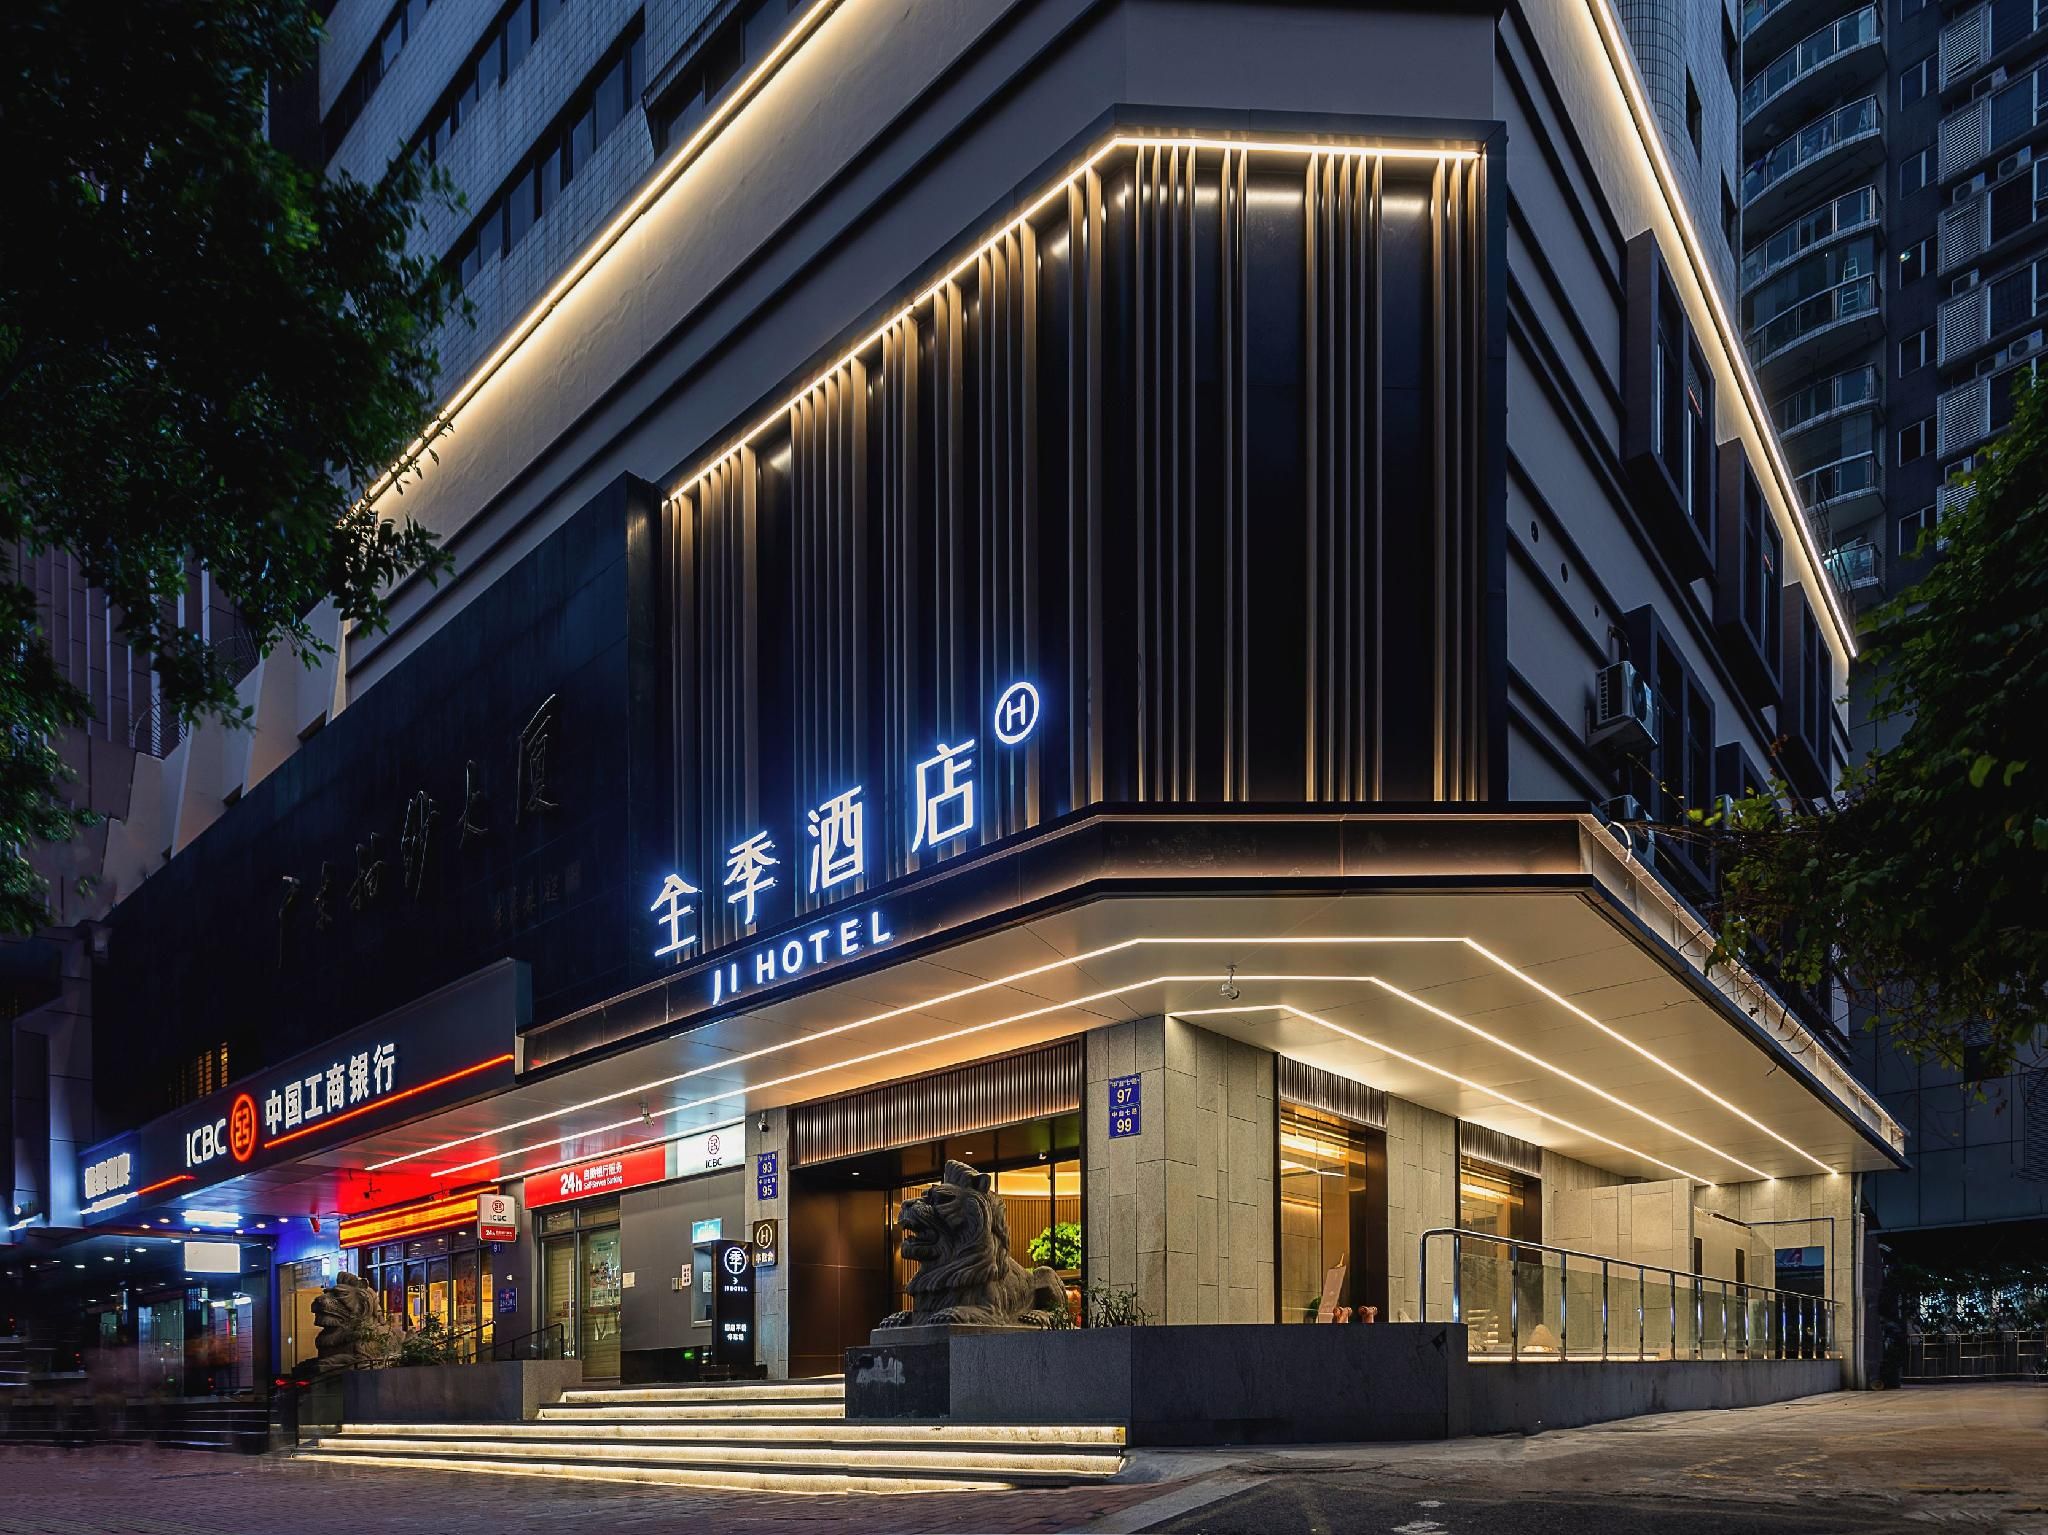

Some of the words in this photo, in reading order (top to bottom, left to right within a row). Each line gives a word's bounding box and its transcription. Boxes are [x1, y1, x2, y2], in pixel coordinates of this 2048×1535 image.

[651, 739, 975, 957] 全季酒店
[712, 964, 738, 1006] JI
[756, 912, 891, 984] HOTEL
[265, 1043, 395, 1136] 中国工商银行
[1117, 1088, 1132, 1104] 97
[1117, 1117, 1132, 1133] 99
[186, 1118, 227, 1167] ICBC
[705, 1156, 723, 1169] ICBC
[763, 1162, 772, 1173] 93
[560, 1171, 583, 1196] 24h
[763, 1185, 772, 1197] 95
